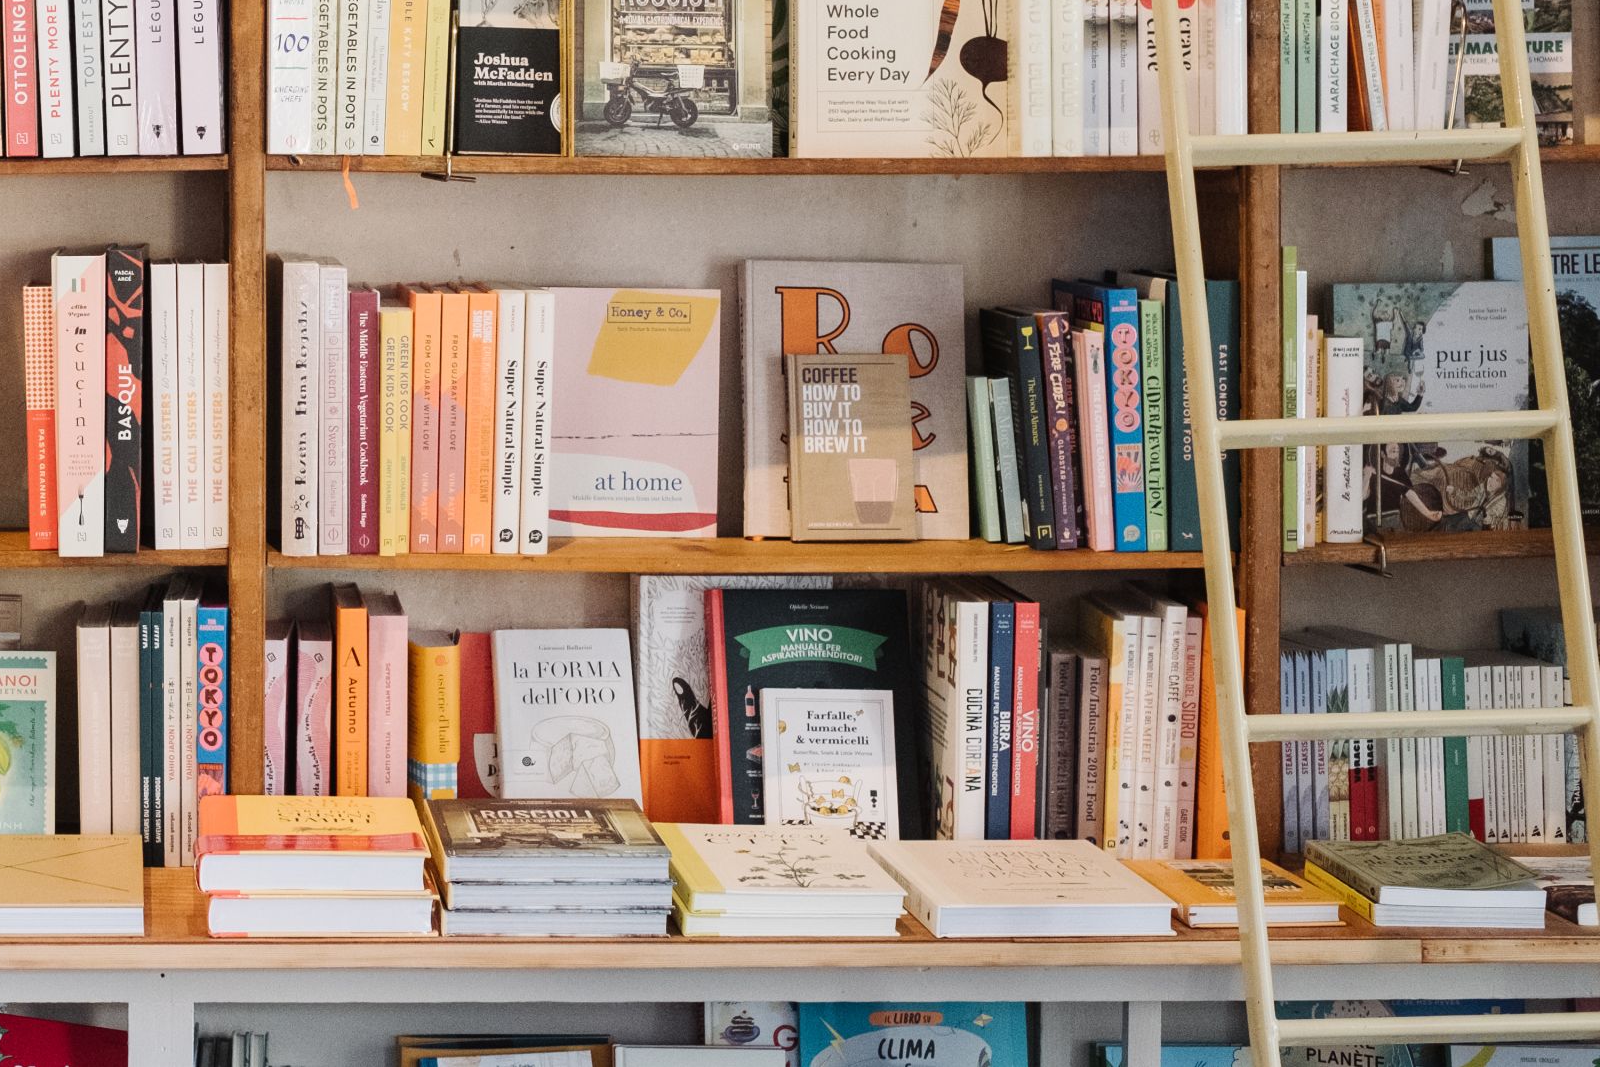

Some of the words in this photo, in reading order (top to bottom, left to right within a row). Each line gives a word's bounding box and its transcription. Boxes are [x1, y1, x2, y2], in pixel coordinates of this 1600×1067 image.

[827, 4, 879, 19] Whole
[828, 25, 869, 40] Food
[474, 53, 529, 67] Joshua
[827, 46, 897, 64] Cooking
[474, 67, 553, 82] McFadden
[828, 67, 875, 85] Every
[879, 67, 910, 85] Day
[346, 78, 356, 90] IN
[345, 94, 356, 130] POTS
[611, 307, 651, 320] Honey
[655, 307, 664, 318] &
[668, 307, 688, 319] Co.
[1436, 347, 1472, 368] pur
[1479, 345, 1508, 367] jus
[537, 360, 548, 398] Super
[802, 367, 858, 384] COFFEE
[1119, 328, 1134, 427] TOKYO
[1436, 368, 1508, 380] vinification
[802, 385, 840, 401] HOW
[843, 385, 861, 401] TO
[118, 363, 135, 441] BASQUE
[803, 402, 836, 418] BUY
[839, 402, 850, 418] IT
[535, 401, 547, 452] Natural
[804, 419, 841, 435] HOW
[844, 419, 863, 435] TO
[805, 437, 850, 453] BREW
[853, 436, 867, 453] IT
[533, 455, 547, 497] Simple
[594, 473, 618, 491] at
[622, 471, 683, 491] home
[786, 628, 832, 642] VINO
[781, 644, 820, 653] MANUALE
[823, 643, 841, 652] PER
[761, 651, 806, 663] ASPIRANTI
[808, 651, 863, 663] INTENDITORI
[513, 662, 529, 678] la
[538, 661, 621, 679] FORMA
[204, 647, 217, 748] TOKYO
[522, 687, 616, 705] dell'ORO
[348, 677, 357, 735] Autunno
[967, 689, 982, 732] CUCINA
[806, 710, 856, 722] Farfalle,
[806, 723, 858, 733] lumache
[796, 735, 805, 745] &
[808, 735, 869, 746] vermicelli
[966, 737, 981, 792] COREANA
[480, 809, 592, 820] ROSCIOLI
[877, 1038, 935, 1060] CLIMA
[1306, 1047, 1385, 1066] PLANÈTE
